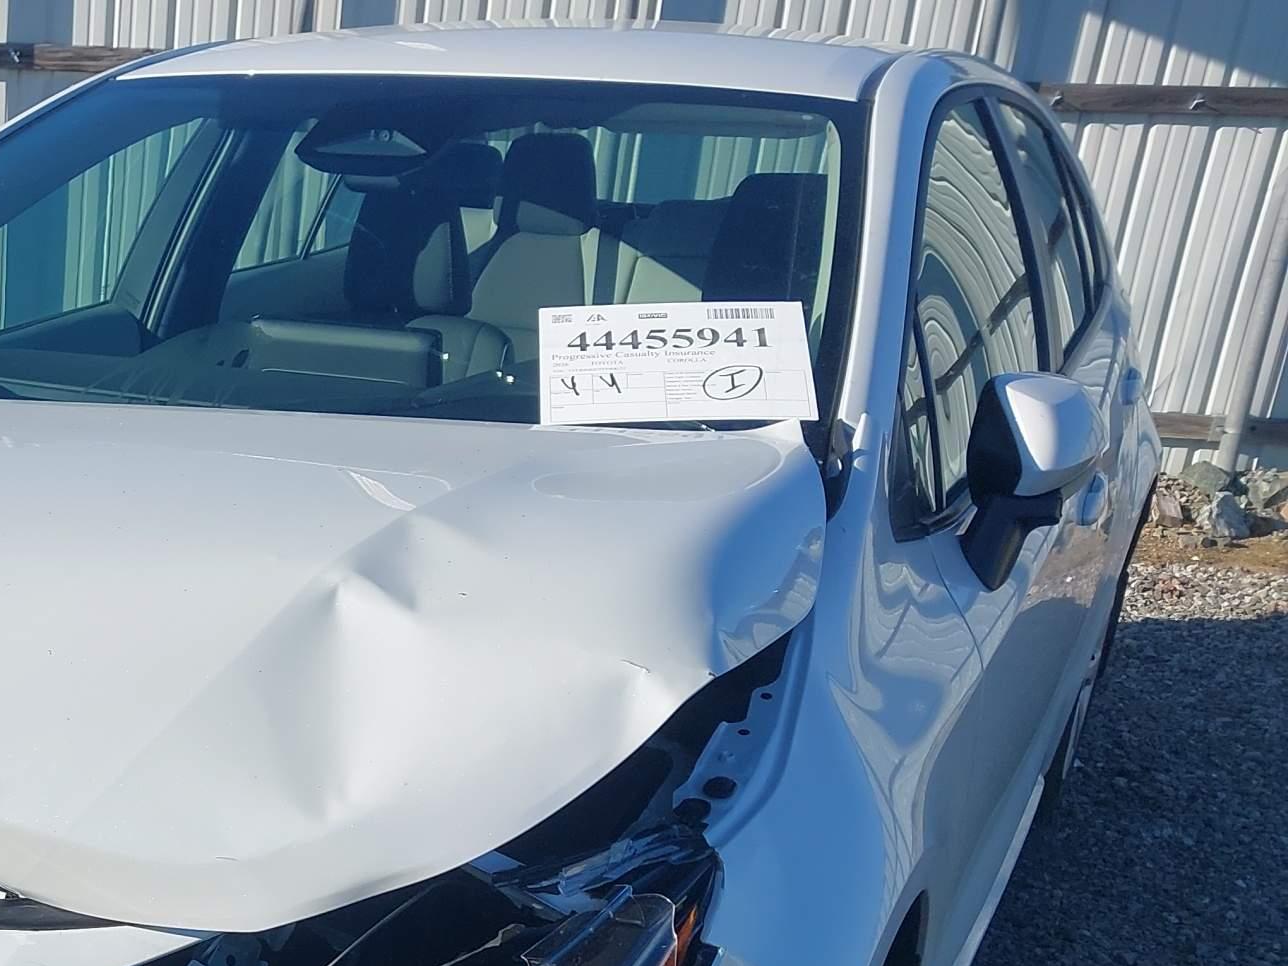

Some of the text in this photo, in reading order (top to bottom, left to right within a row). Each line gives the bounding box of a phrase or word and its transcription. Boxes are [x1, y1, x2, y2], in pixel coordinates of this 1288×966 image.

[567, 327, 774, 351] 44455941
[551, 353, 612, 361] Progressive
[615, 350, 660, 359] Casualty
